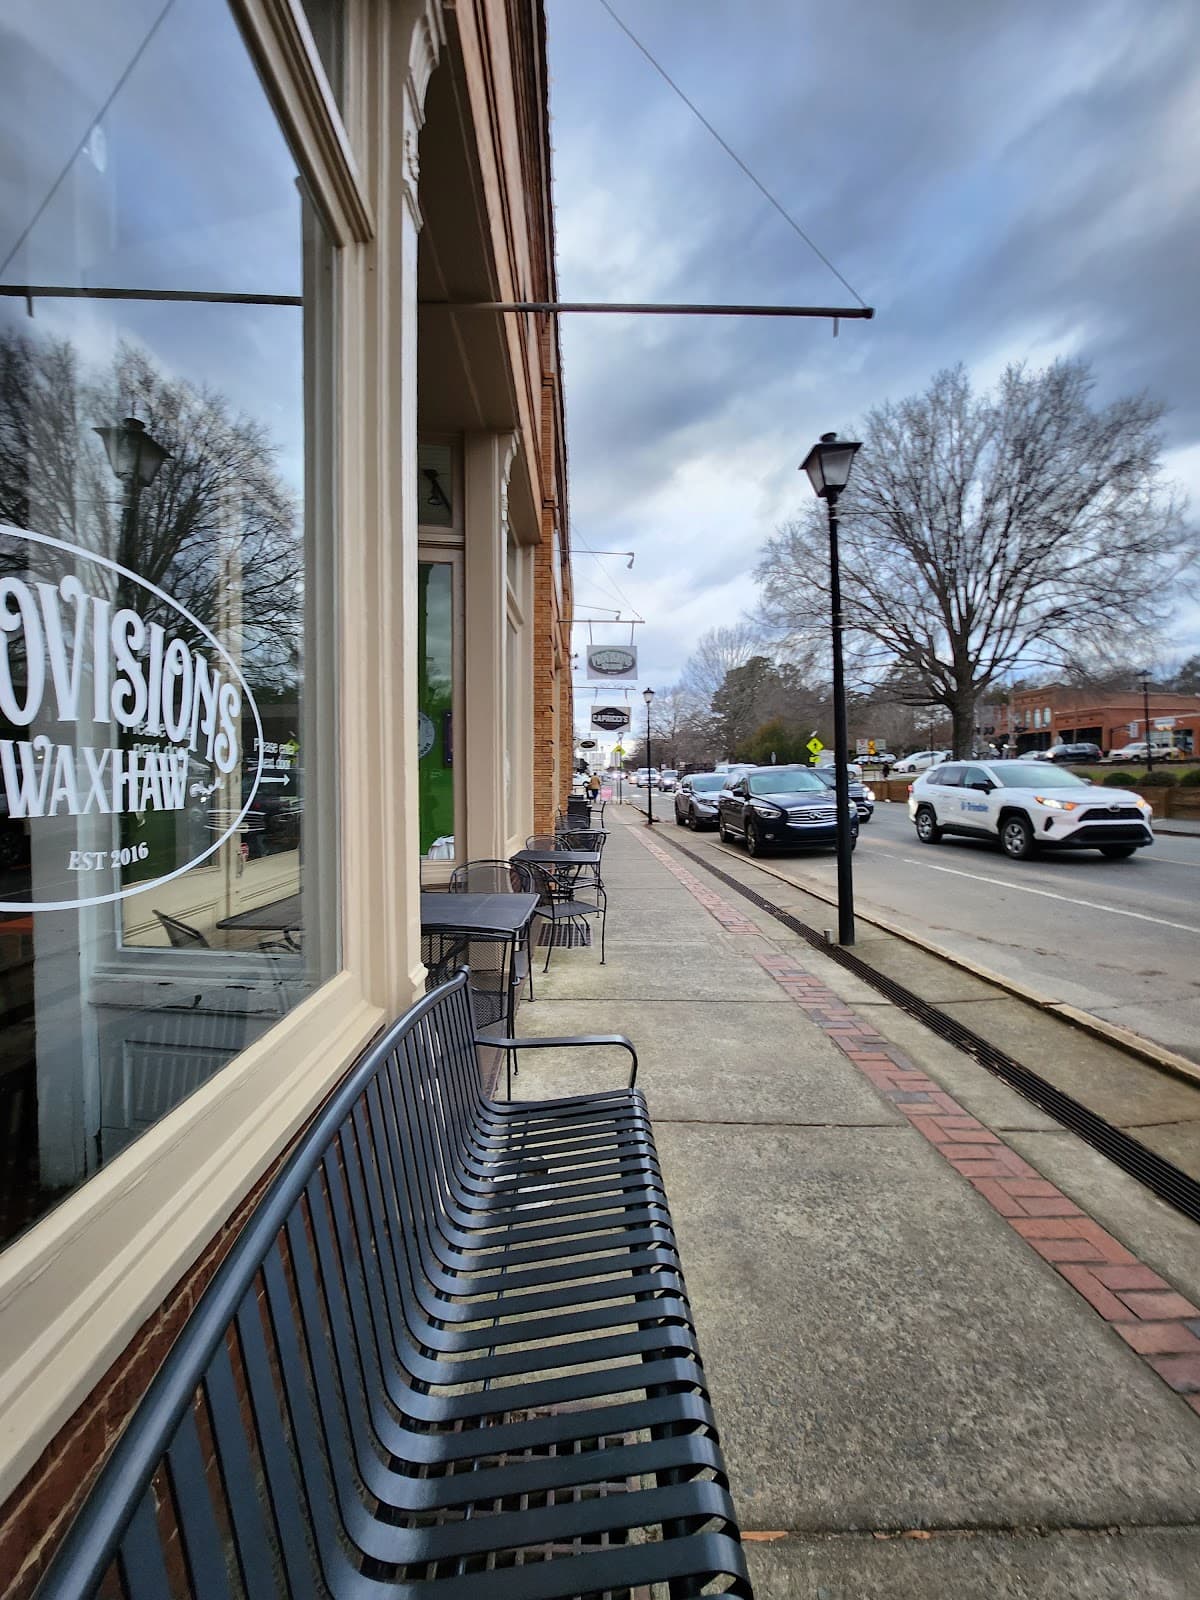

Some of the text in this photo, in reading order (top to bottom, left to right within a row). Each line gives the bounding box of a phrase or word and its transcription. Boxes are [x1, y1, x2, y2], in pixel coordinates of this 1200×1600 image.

[0, 735, 190, 819] WAXHAW
[67, 841, 150, 872] EST 2016
